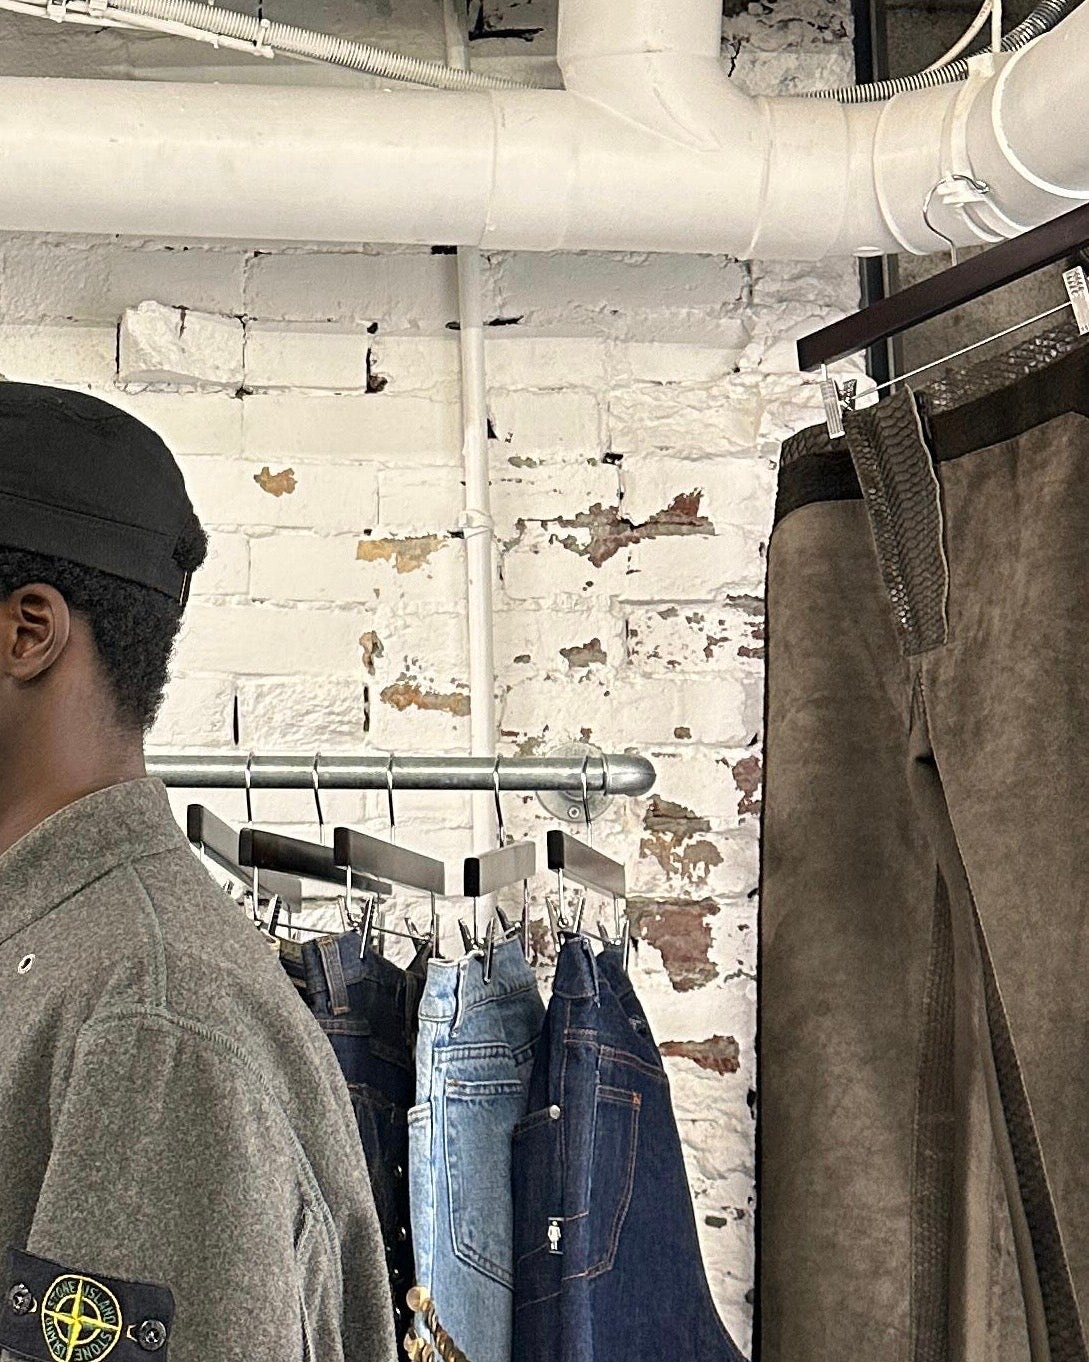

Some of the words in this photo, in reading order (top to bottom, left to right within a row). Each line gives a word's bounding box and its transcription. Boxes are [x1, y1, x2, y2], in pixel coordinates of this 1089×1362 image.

[47, 1280, 76, 1309] STONE
[84, 1284, 117, 1324] ISLAND
[73, 1331, 113, 1361] STONE
